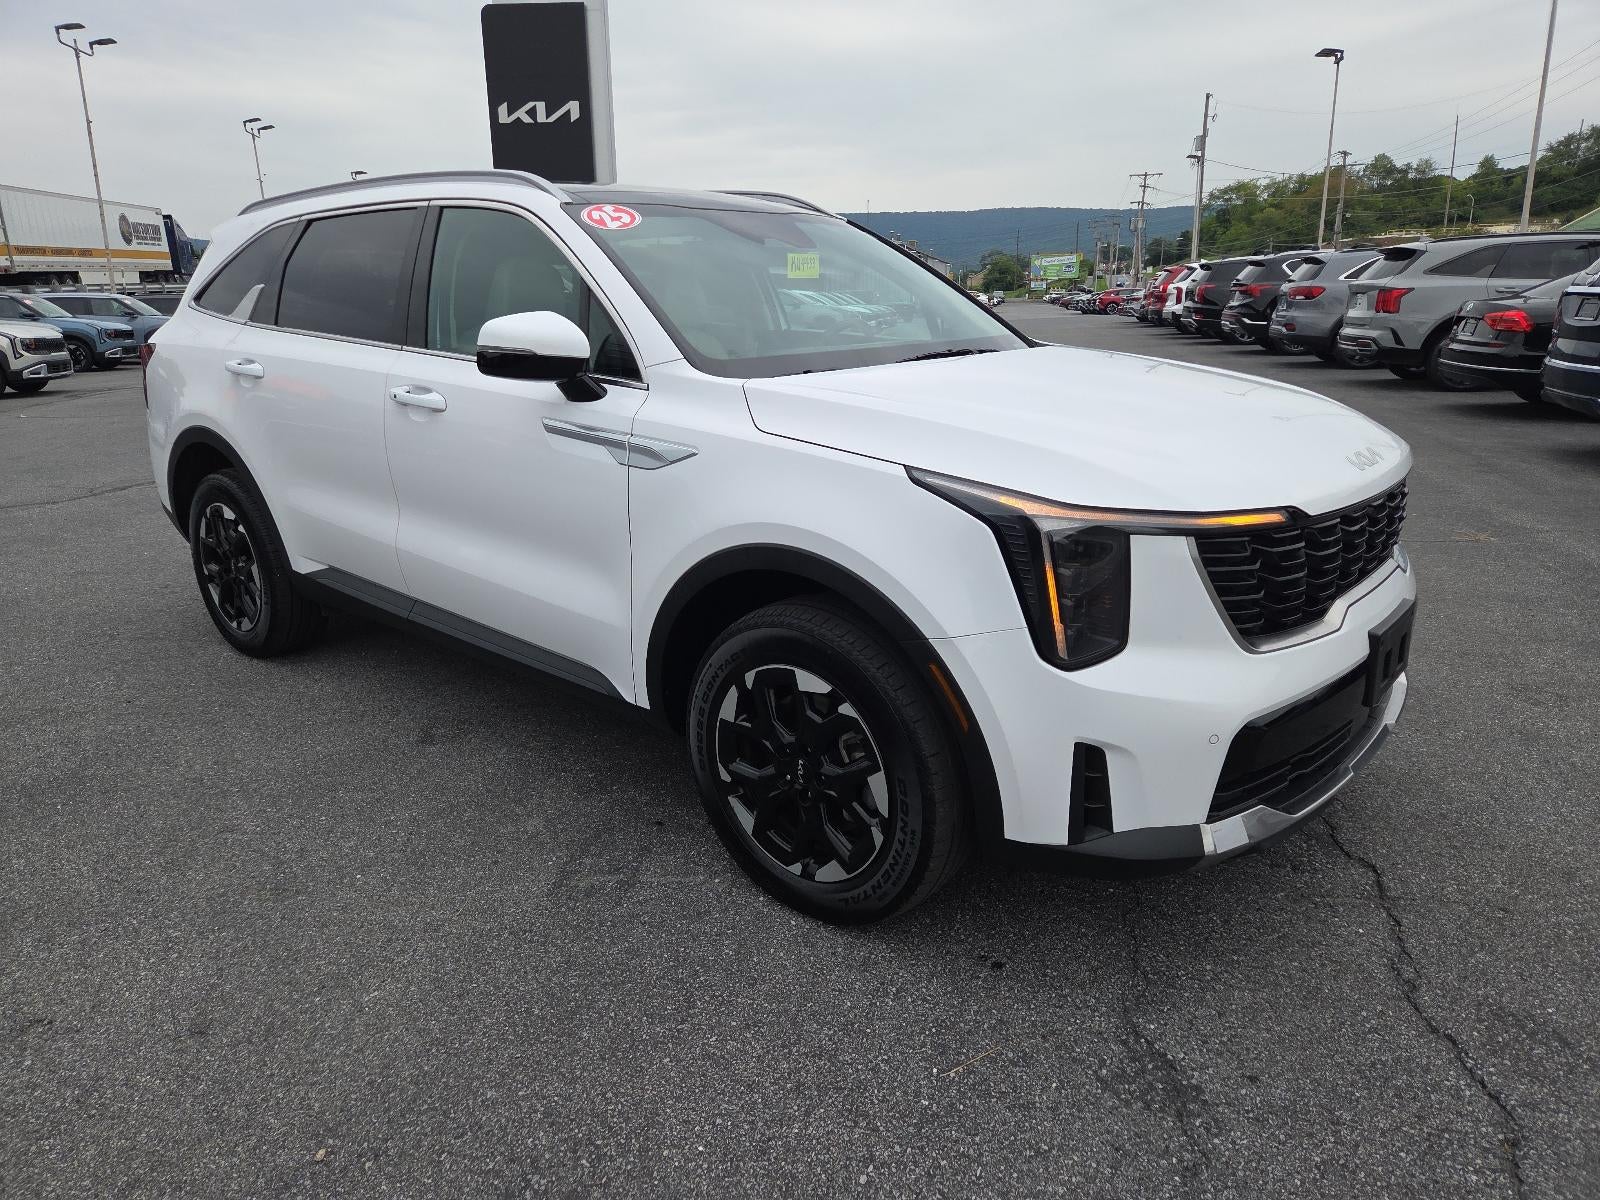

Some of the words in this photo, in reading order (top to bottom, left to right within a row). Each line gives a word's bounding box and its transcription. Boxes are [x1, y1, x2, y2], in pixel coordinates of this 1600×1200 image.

[497, 100, 580, 124] KIA
[591, 205, 631, 228] 25
[1344, 446, 1384, 471] KIA
[837, 775, 910, 907] CONTINENTAL
